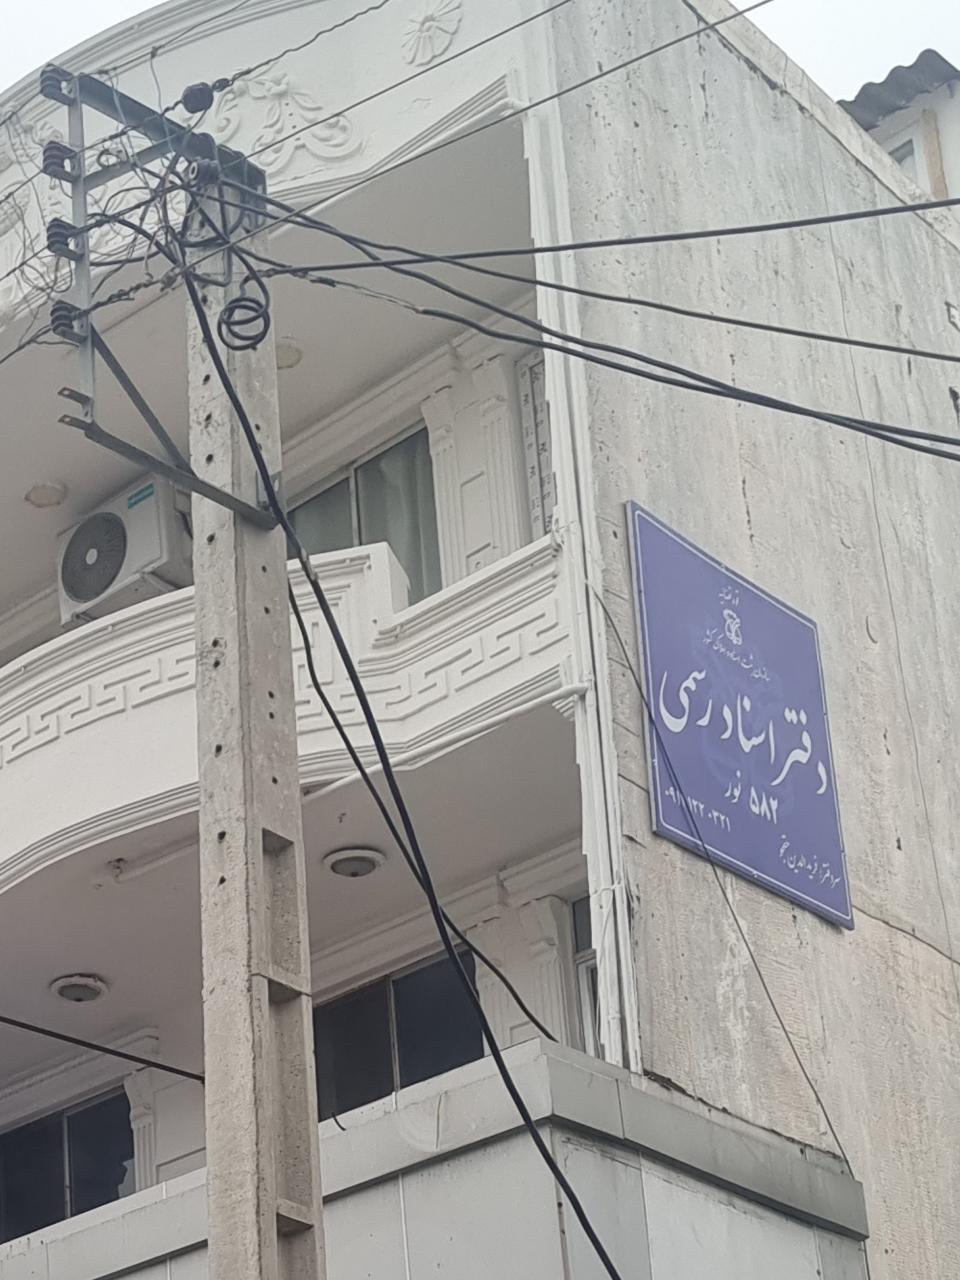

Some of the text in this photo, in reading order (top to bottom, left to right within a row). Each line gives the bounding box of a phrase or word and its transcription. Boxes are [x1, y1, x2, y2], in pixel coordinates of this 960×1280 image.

[658, 668, 828, 796] دفتر اسناد رسمی
[724, 769, 778, 825] ۵۸۲ نور
